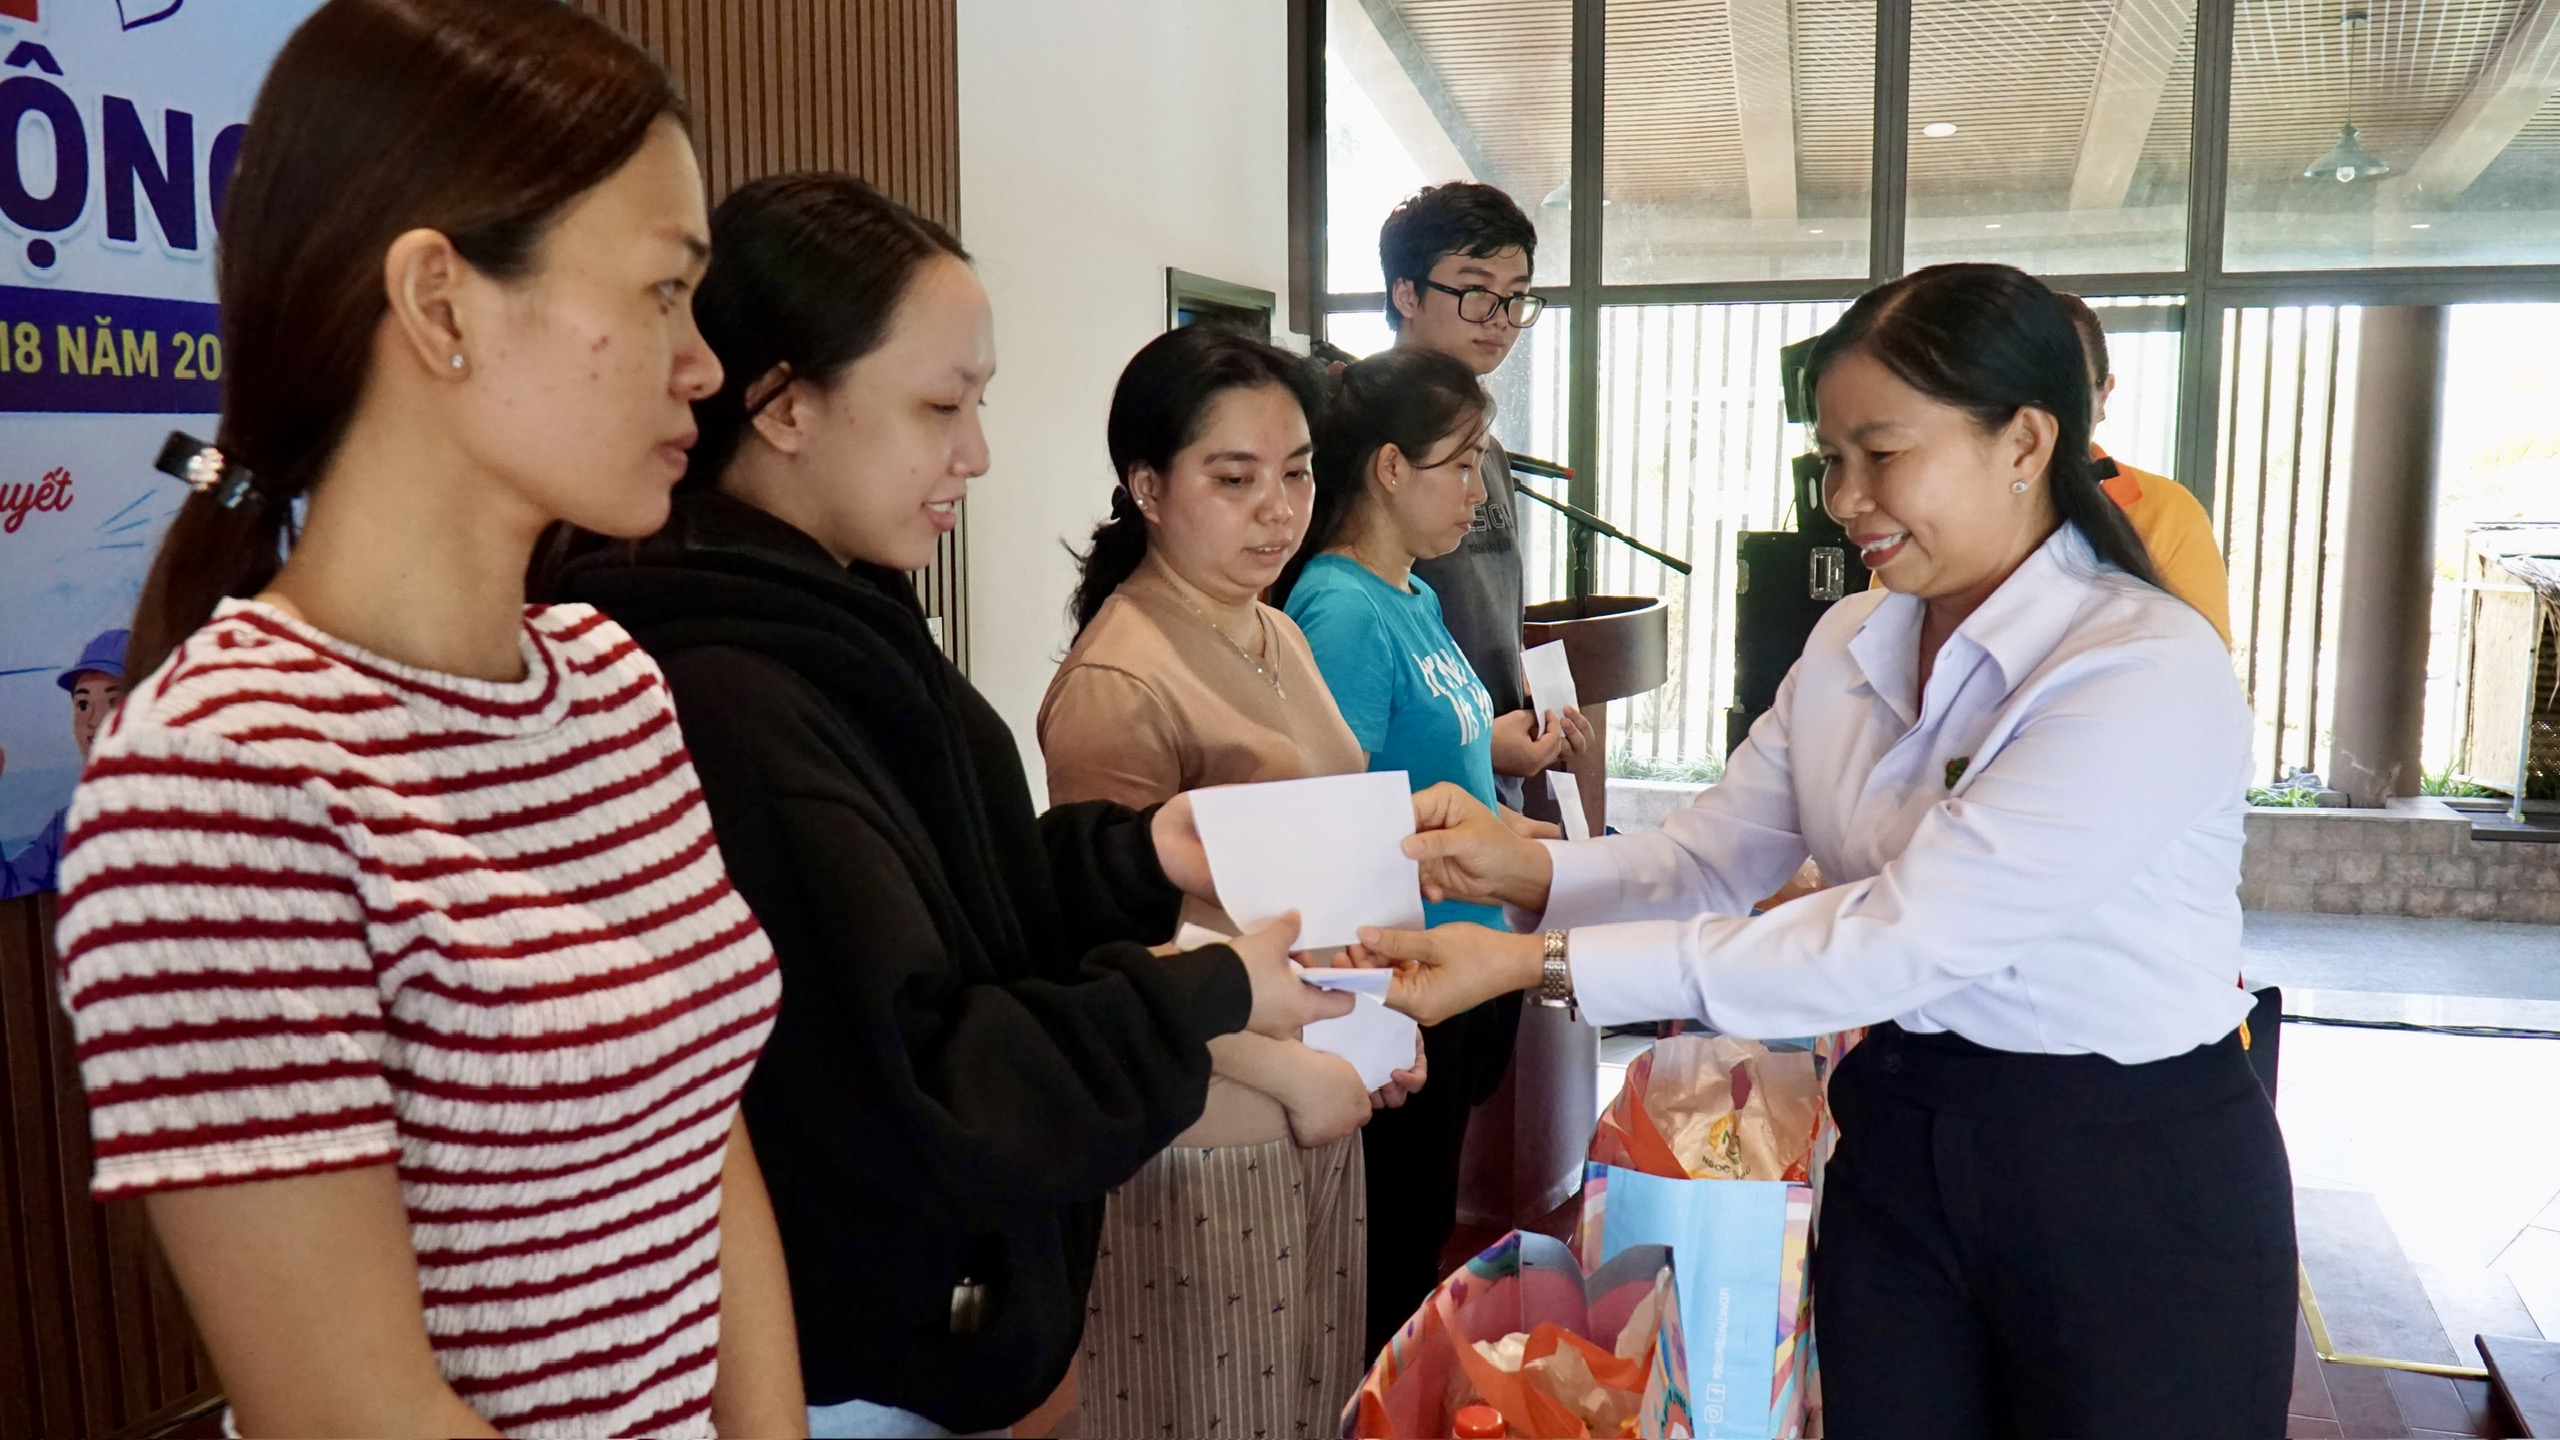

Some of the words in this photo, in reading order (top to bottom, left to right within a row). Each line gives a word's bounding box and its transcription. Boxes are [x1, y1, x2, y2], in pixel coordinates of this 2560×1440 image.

[0, 41, 250, 268] ỘN
[57, 315, 159, 378] NĂM
[0, 466, 74, 533] uyết
